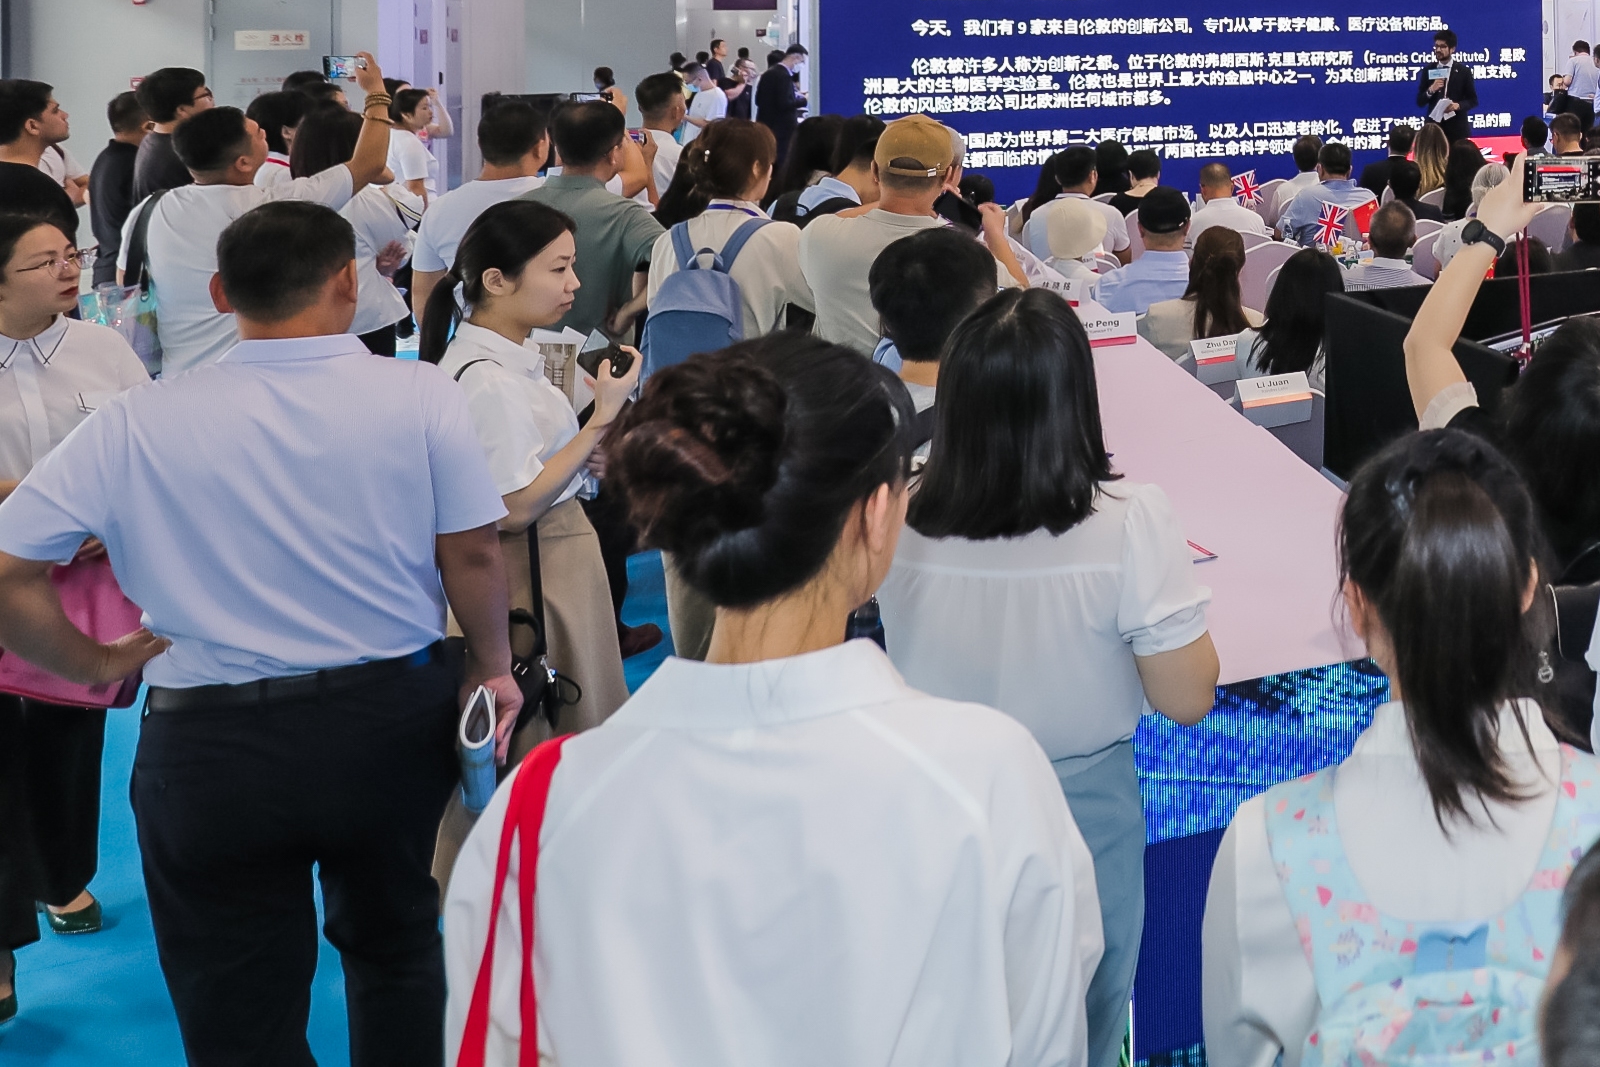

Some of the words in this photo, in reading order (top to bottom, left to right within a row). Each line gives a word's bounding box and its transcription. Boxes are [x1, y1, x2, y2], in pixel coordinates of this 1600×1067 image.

[1017, 22, 1027, 35] 9
[1410, 50, 1438, 64] Crick
[1499, 47, 1526, 63] 是欧
[1096, 319, 1120, 328] Peng
[1205, 341, 1221, 349] Zhu
[1256, 381, 1265, 389] Li
[1268, 378, 1290, 387] Juan
